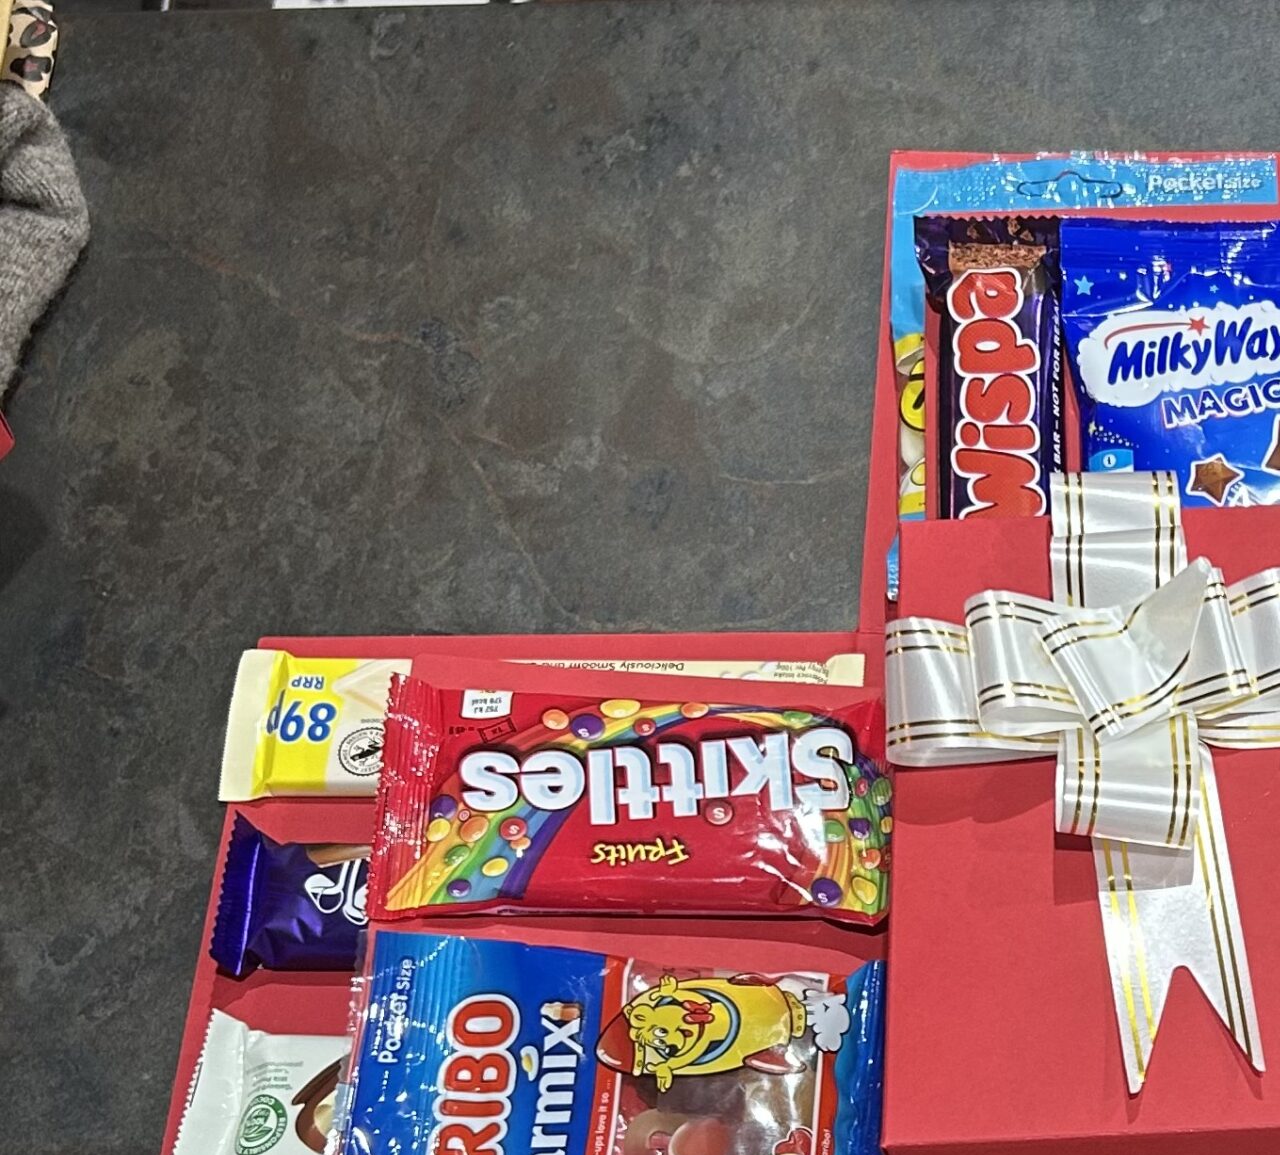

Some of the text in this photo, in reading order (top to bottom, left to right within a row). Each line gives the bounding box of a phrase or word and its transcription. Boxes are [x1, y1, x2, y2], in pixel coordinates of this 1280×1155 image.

[1052, 349, 1061, 381] FOR
[1051, 383, 1061, 417] NOT
[1053, 432, 1062, 465] BAR
[291, 675, 325, 690] RRP
[621, 661, 685, 673] Deliciously
[459, 727, 855, 826] Skittles
[591, 838, 690, 866] Fruits
